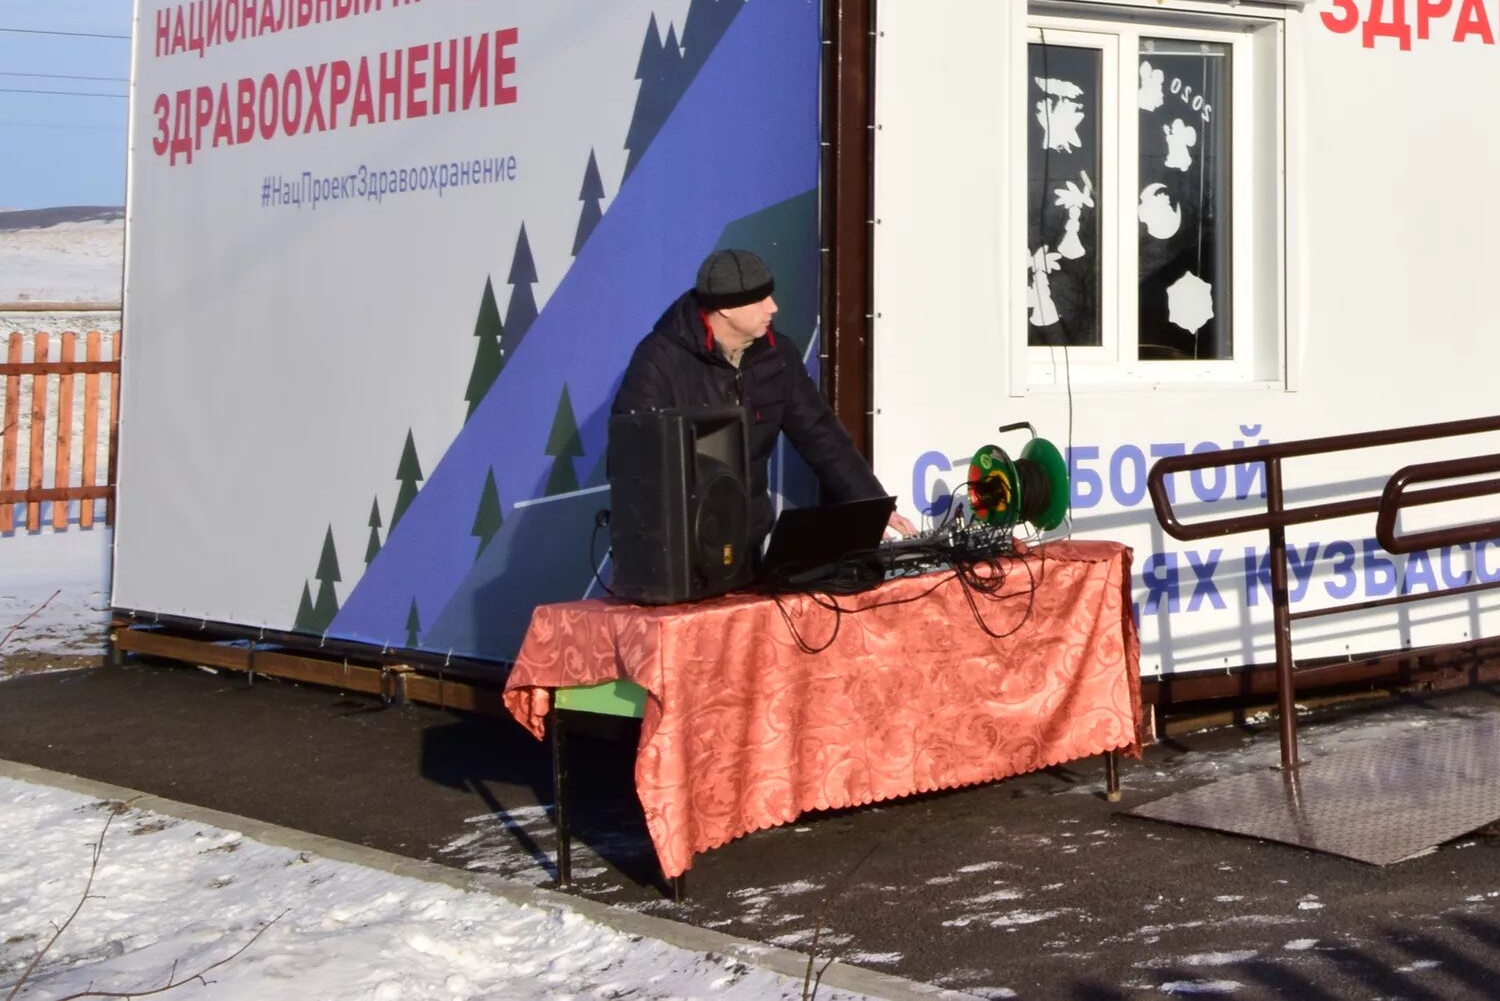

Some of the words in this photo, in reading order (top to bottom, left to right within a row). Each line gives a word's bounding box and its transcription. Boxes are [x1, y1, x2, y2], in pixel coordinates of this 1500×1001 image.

[152, 27, 518, 167] ЗДРАВООХРАНЕНИЕ
[260, 153, 517, 208] #НацПроектЗдравоохранение
[911, 450, 952, 517] С
